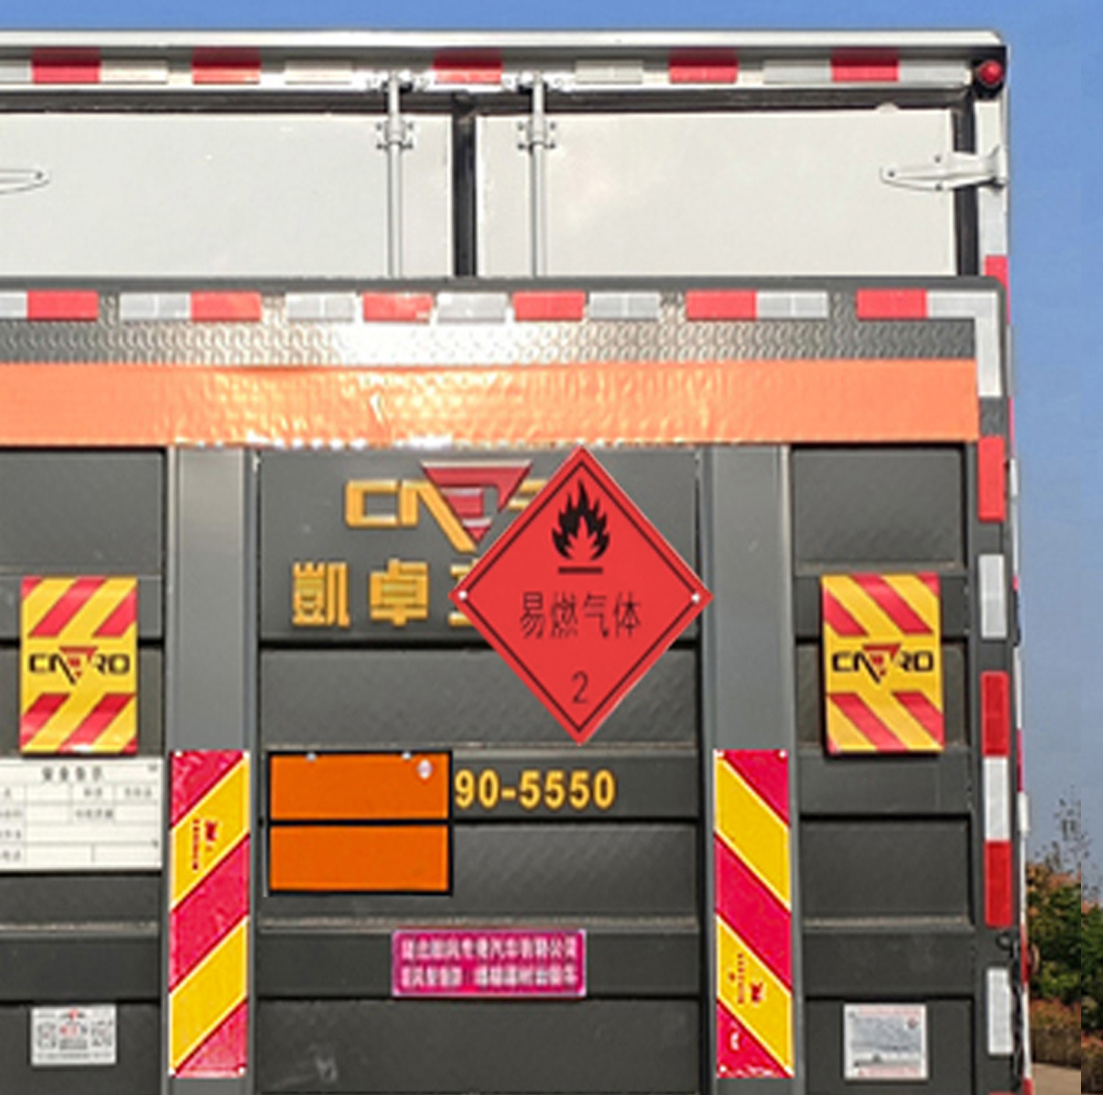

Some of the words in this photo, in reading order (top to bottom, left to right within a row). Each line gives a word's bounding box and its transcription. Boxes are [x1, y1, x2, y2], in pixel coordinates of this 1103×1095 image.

[520, 592, 641, 639] 易燃气体
[571, 670, 589, 704] 2
[454, 769, 616, 810] 90-5550
